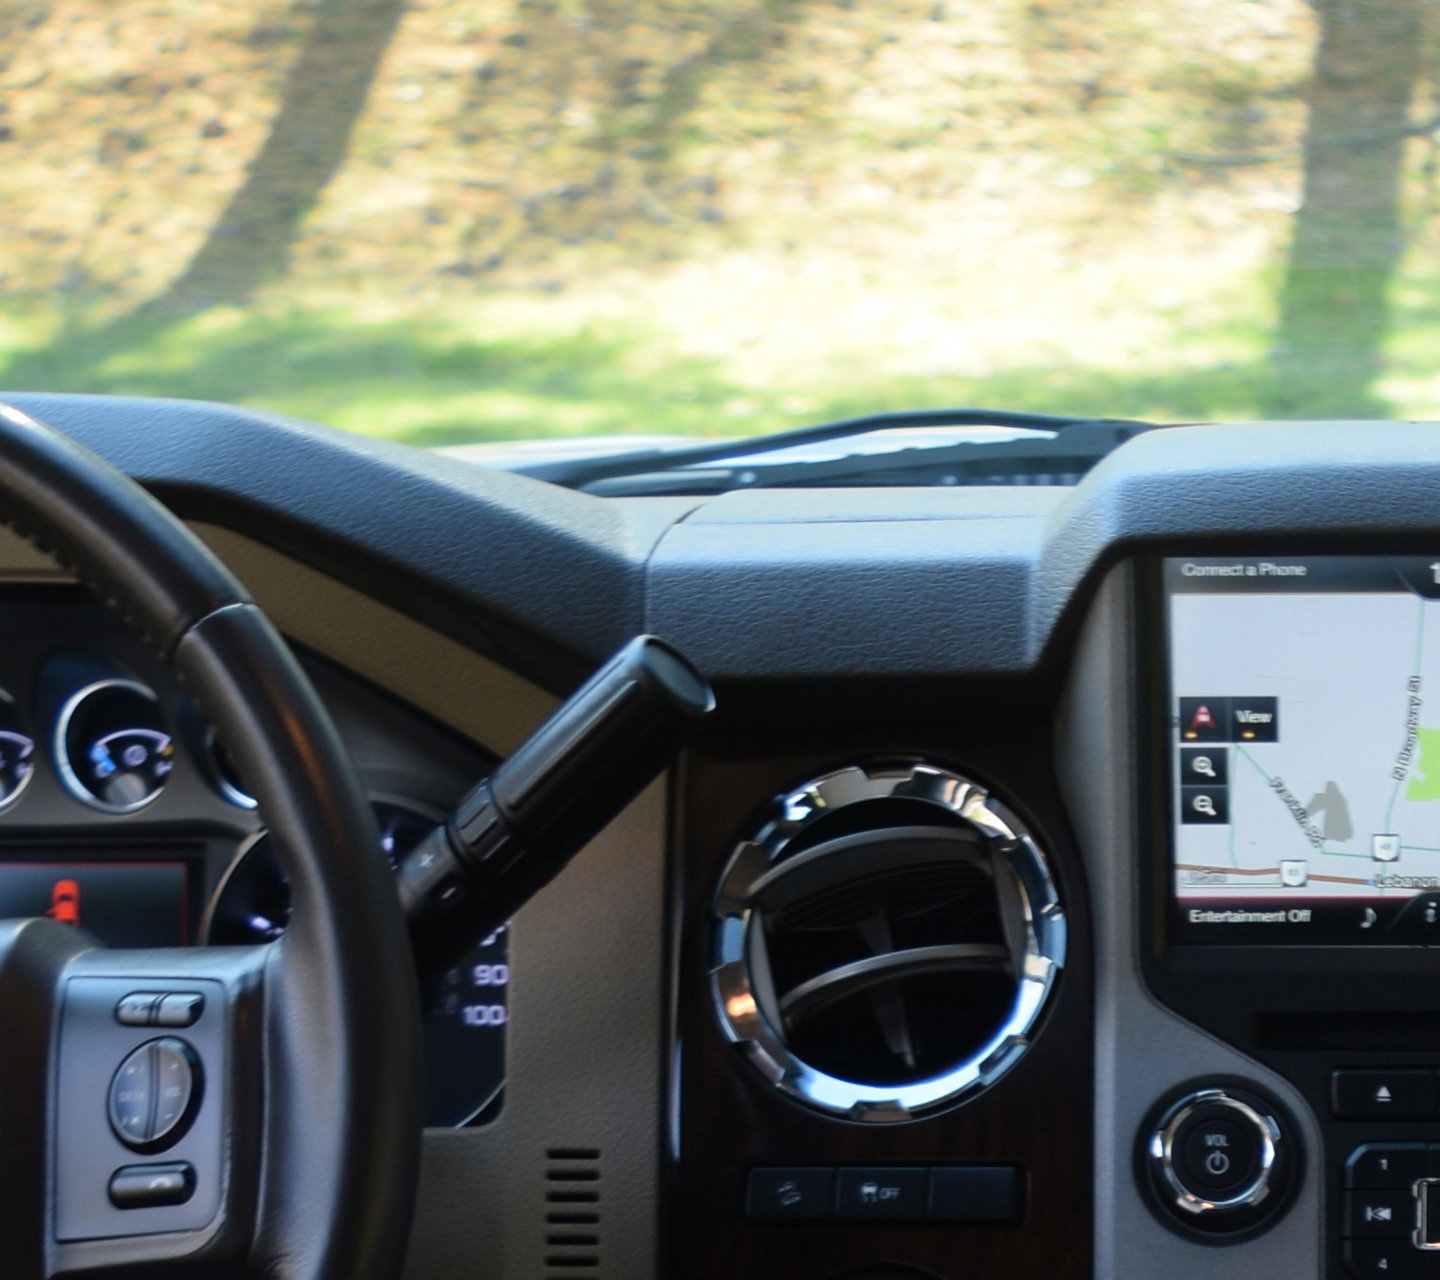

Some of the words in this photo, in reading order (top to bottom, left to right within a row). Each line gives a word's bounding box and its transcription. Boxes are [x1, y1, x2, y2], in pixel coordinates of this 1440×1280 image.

[1181, 563, 1244, 576] Connect
[1258, 562, 1308, 576] Phone
[1235, 709, 1273, 724] View
[1376, 873, 1440, 888] Lebanon
[1189, 908, 1287, 923] Entertainment
[1287, 908, 1312, 923] Off
[472, 963, 509, 987] 90
[462, 1004, 508, 1027] 100
[1205, 1134, 1230, 1148] VOL
[1379, 1158, 1389, 1171] 1
[879, 1187, 902, 1200] OFF
[1377, 1257, 1389, 1270] 4
